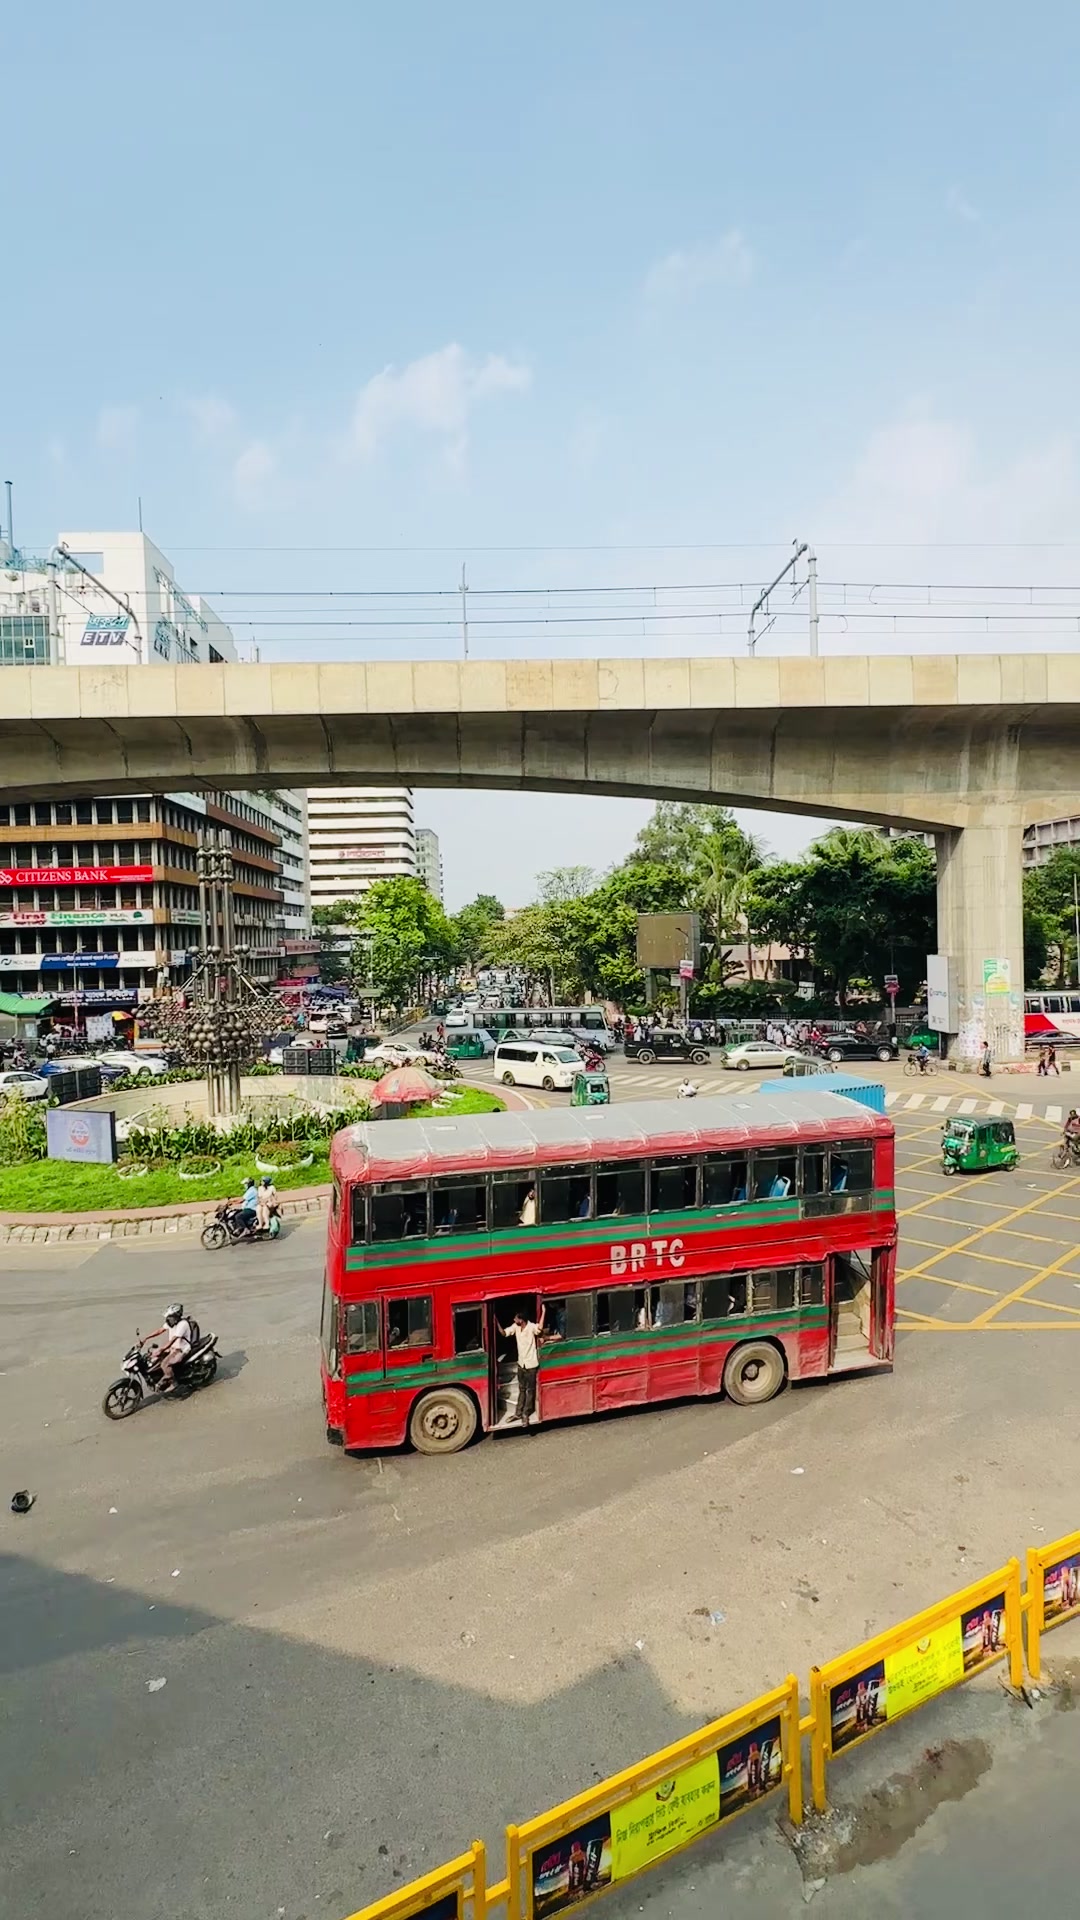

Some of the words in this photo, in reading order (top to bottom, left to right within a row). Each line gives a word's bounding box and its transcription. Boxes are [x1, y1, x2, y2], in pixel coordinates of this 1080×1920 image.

[82, 632, 121, 643] ETV
[16, 871, 72, 882] CITIZENS
[74, 869, 108, 881] BANK
[610, 1238, 686, 1274] BRTC
